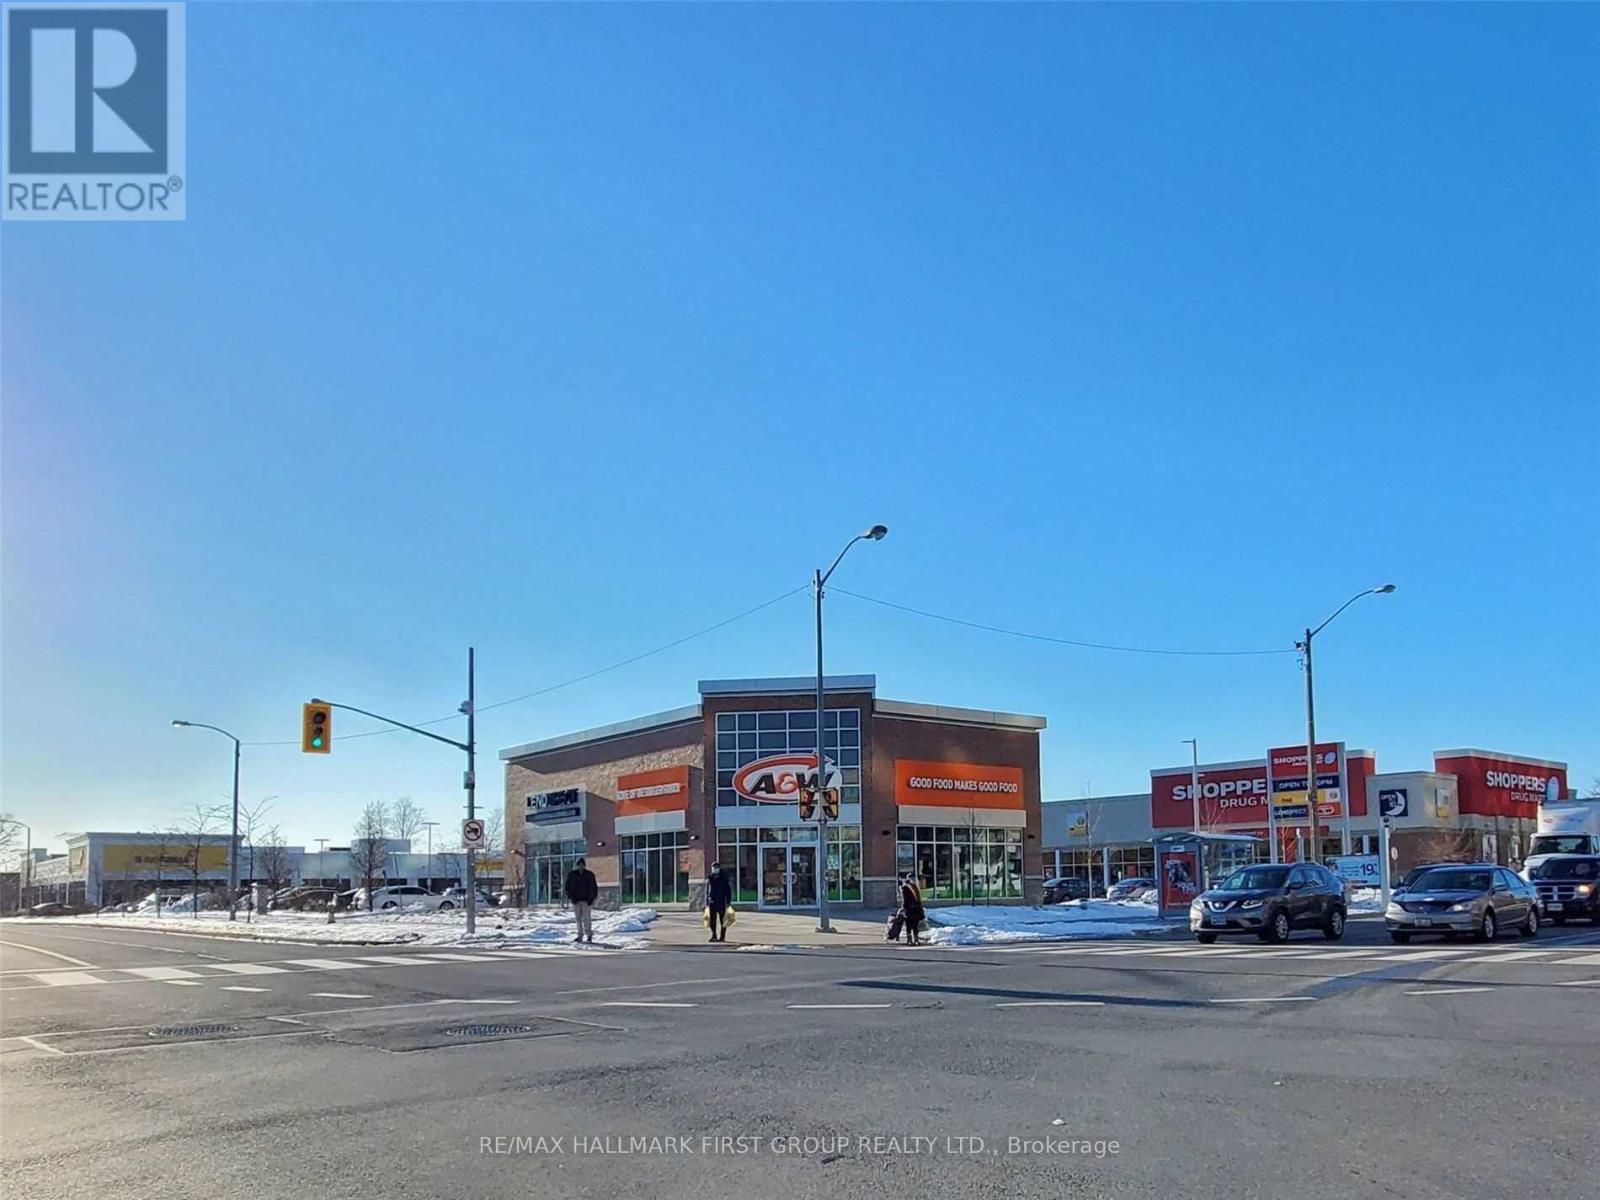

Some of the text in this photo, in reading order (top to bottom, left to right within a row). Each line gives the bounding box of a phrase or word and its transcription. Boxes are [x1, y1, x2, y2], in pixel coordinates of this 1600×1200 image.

[749, 771, 835, 795] A&W
[910, 776, 1018, 793] GOOD FOOD MAKES GOOD FOOD
[1172, 778, 1267, 801] SHOPPE
[1486, 770, 1546, 793] SHOPPERS
[1220, 796, 1257, 808] DRUG
